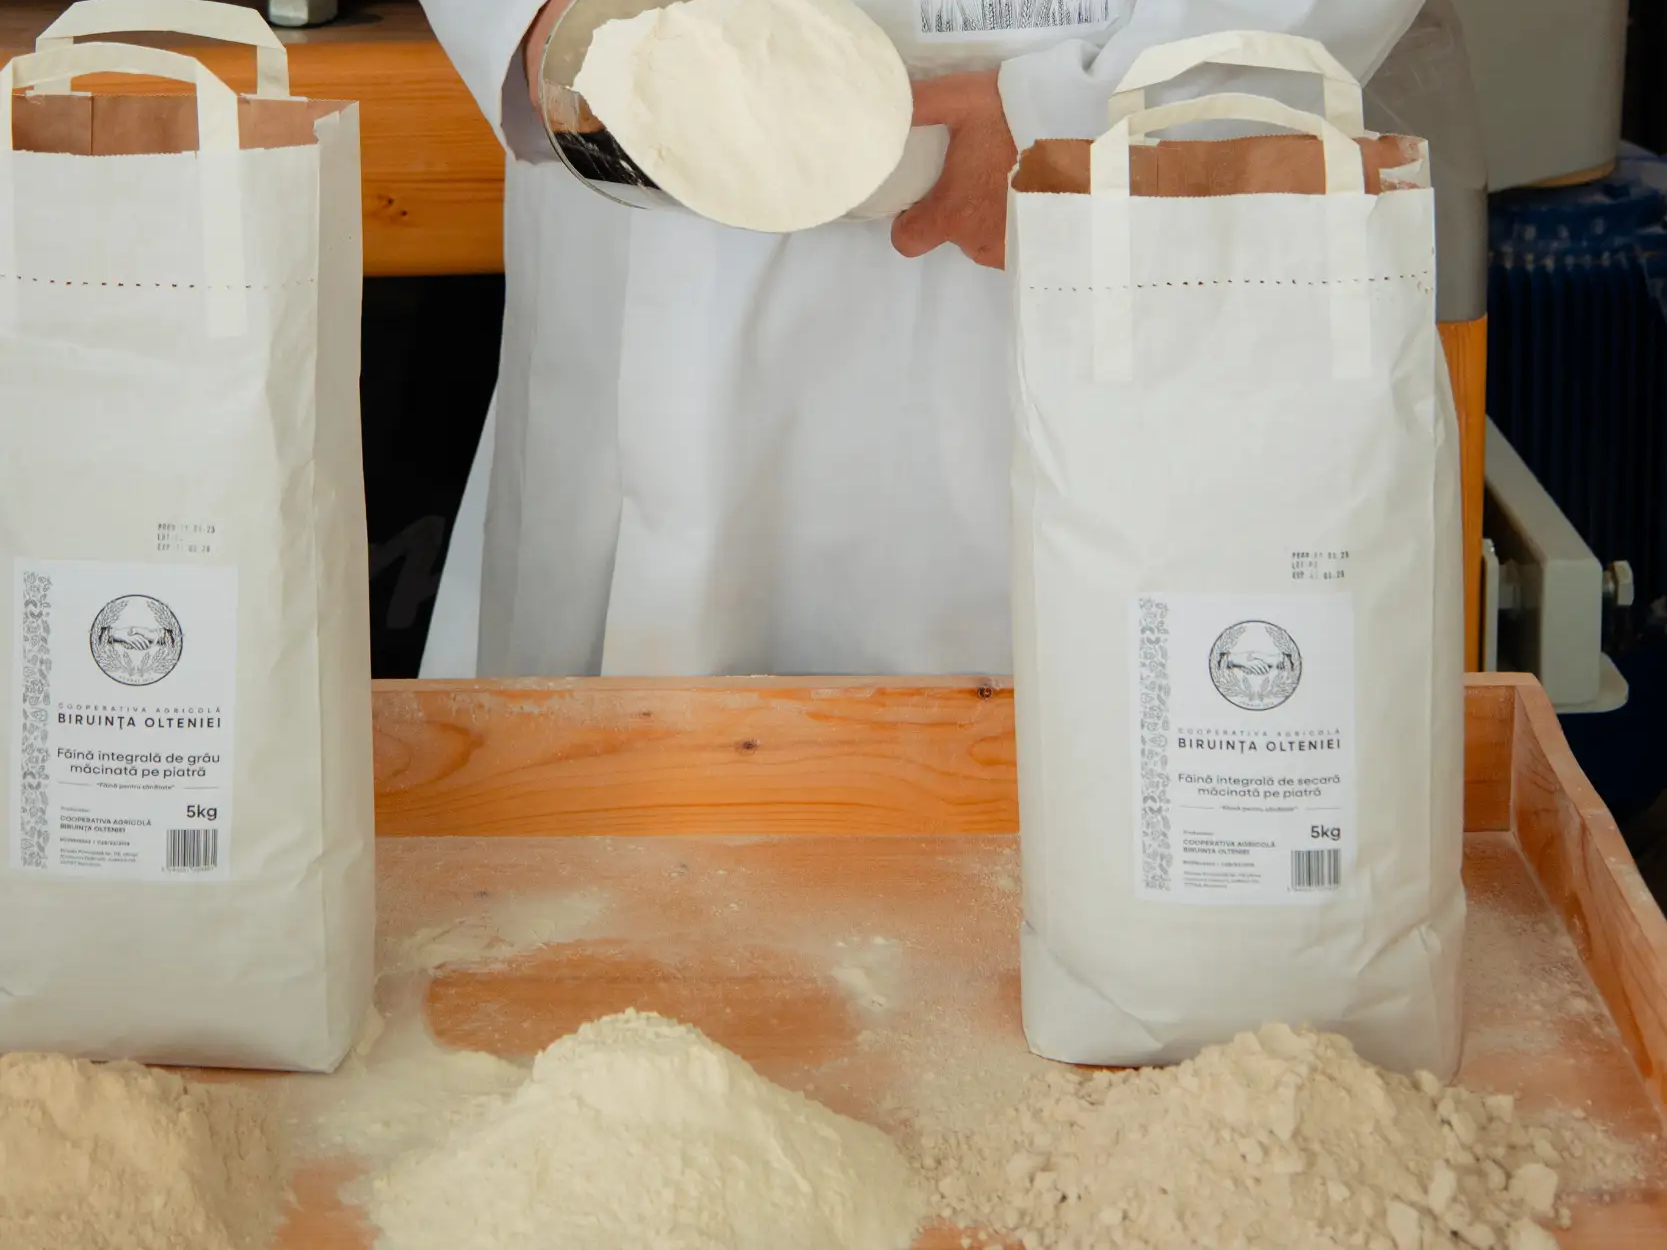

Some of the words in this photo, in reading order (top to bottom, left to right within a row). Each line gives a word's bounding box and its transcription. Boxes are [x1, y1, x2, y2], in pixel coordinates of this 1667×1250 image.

[58, 703, 146, 713] COOPERATIVA
[144, 717, 221, 729] OLTENIEI
[1178, 728, 1268, 737] COOPERATIVA
[1266, 738, 1341, 752] OLTENIEI
[57, 748, 94, 760] Făină
[98, 751, 162, 764] integrală
[166, 752, 184, 763] de
[188, 753, 220, 766] grâu
[70, 764, 138, 776] măcinată
[141, 769, 159, 778] pe
[163, 766, 206, 779] piatră
[1178, 774, 1213, 784] Făină
[1216, 775, 1274, 787] integrală
[1278, 776, 1294, 786] de
[1298, 774, 1340, 785] secară
[1198, 786, 1260, 797] măcinată
[1263, 790, 1280, 799] pe
[1283, 787, 1322, 799] piatră
[187, 804, 217, 821] 5kg
[60, 816, 111, 825] COOPERATIVA
[1311, 825, 1340, 841] 5kg
